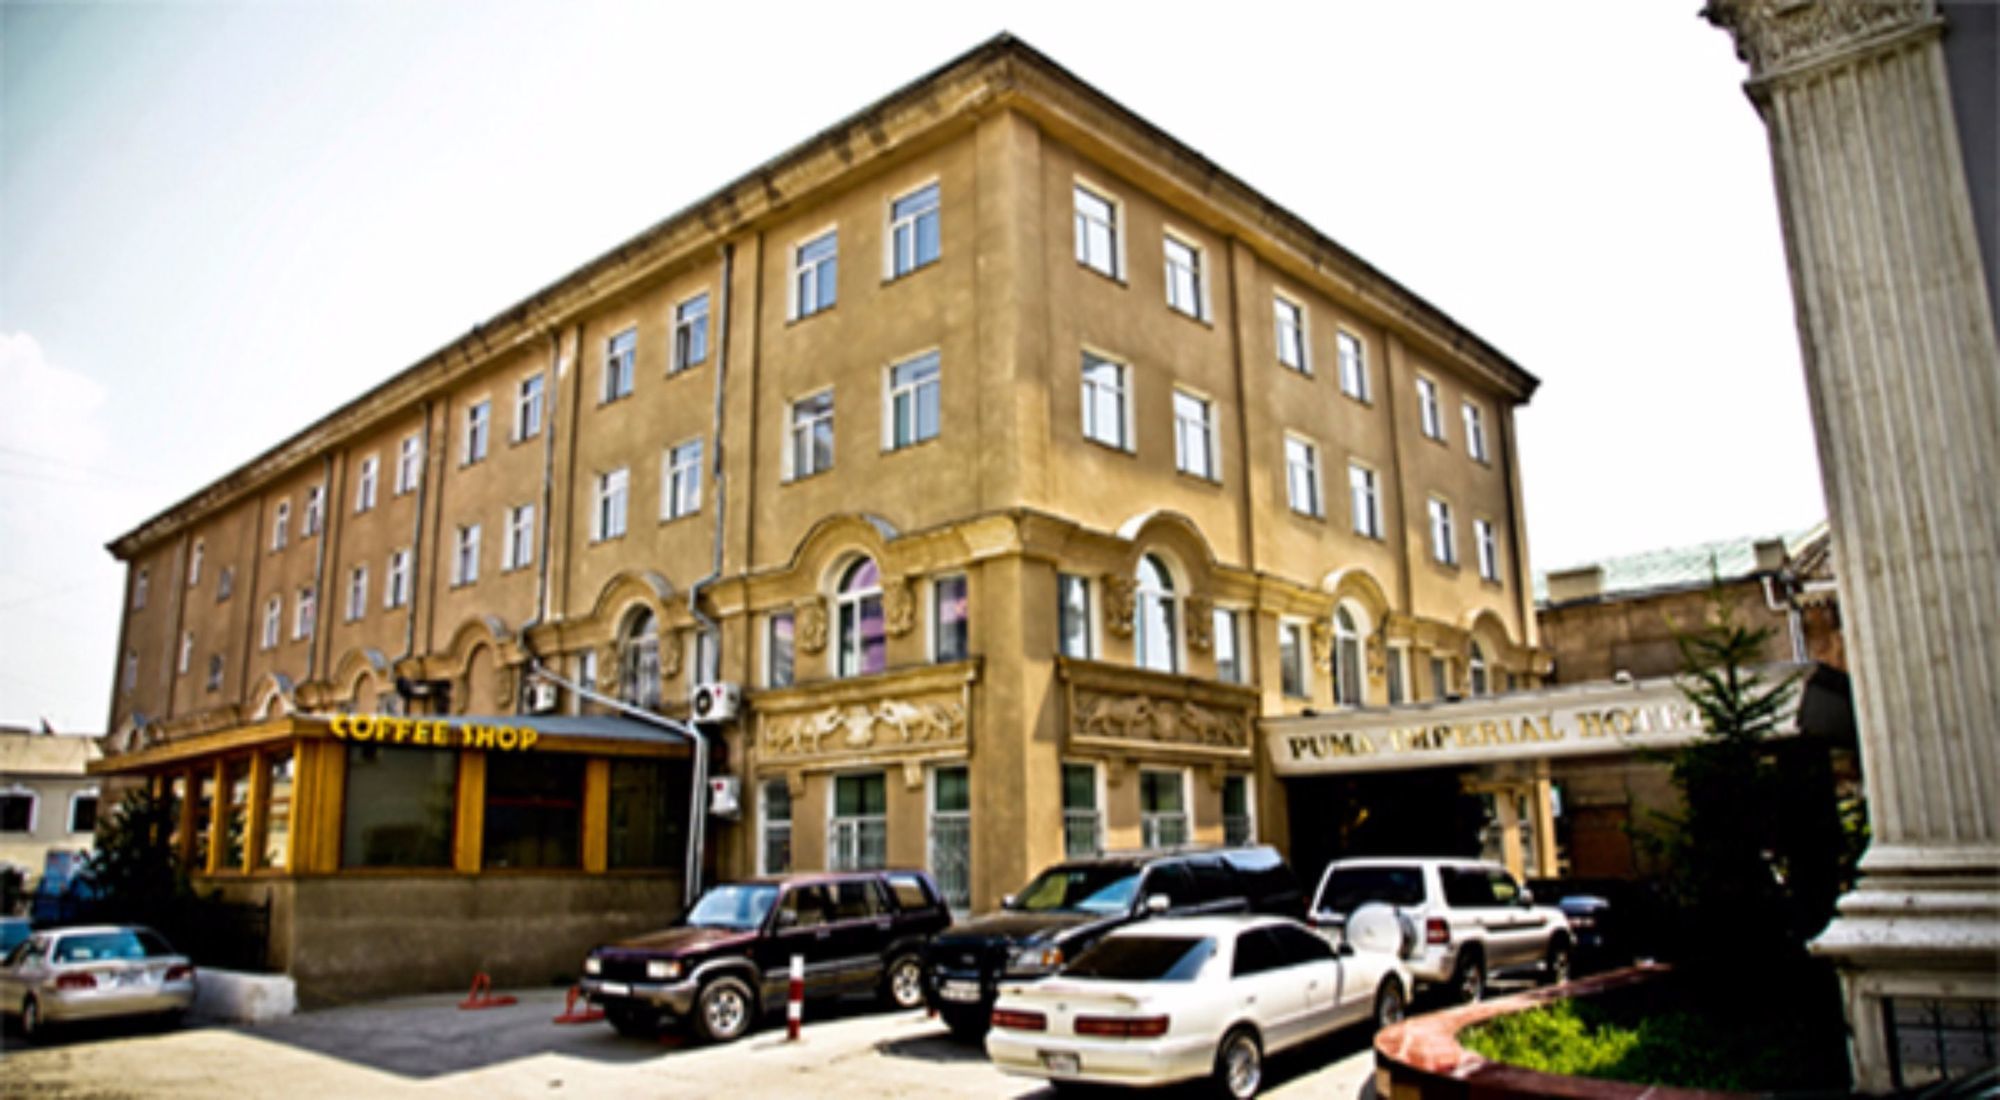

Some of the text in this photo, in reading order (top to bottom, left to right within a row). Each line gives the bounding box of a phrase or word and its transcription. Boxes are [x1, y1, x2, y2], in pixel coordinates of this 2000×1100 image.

[330, 713, 538, 749] COFFEE SHOP
[1288, 733, 1375, 759] PUMA
[1389, 715, 1565, 751] IMPERIAL
